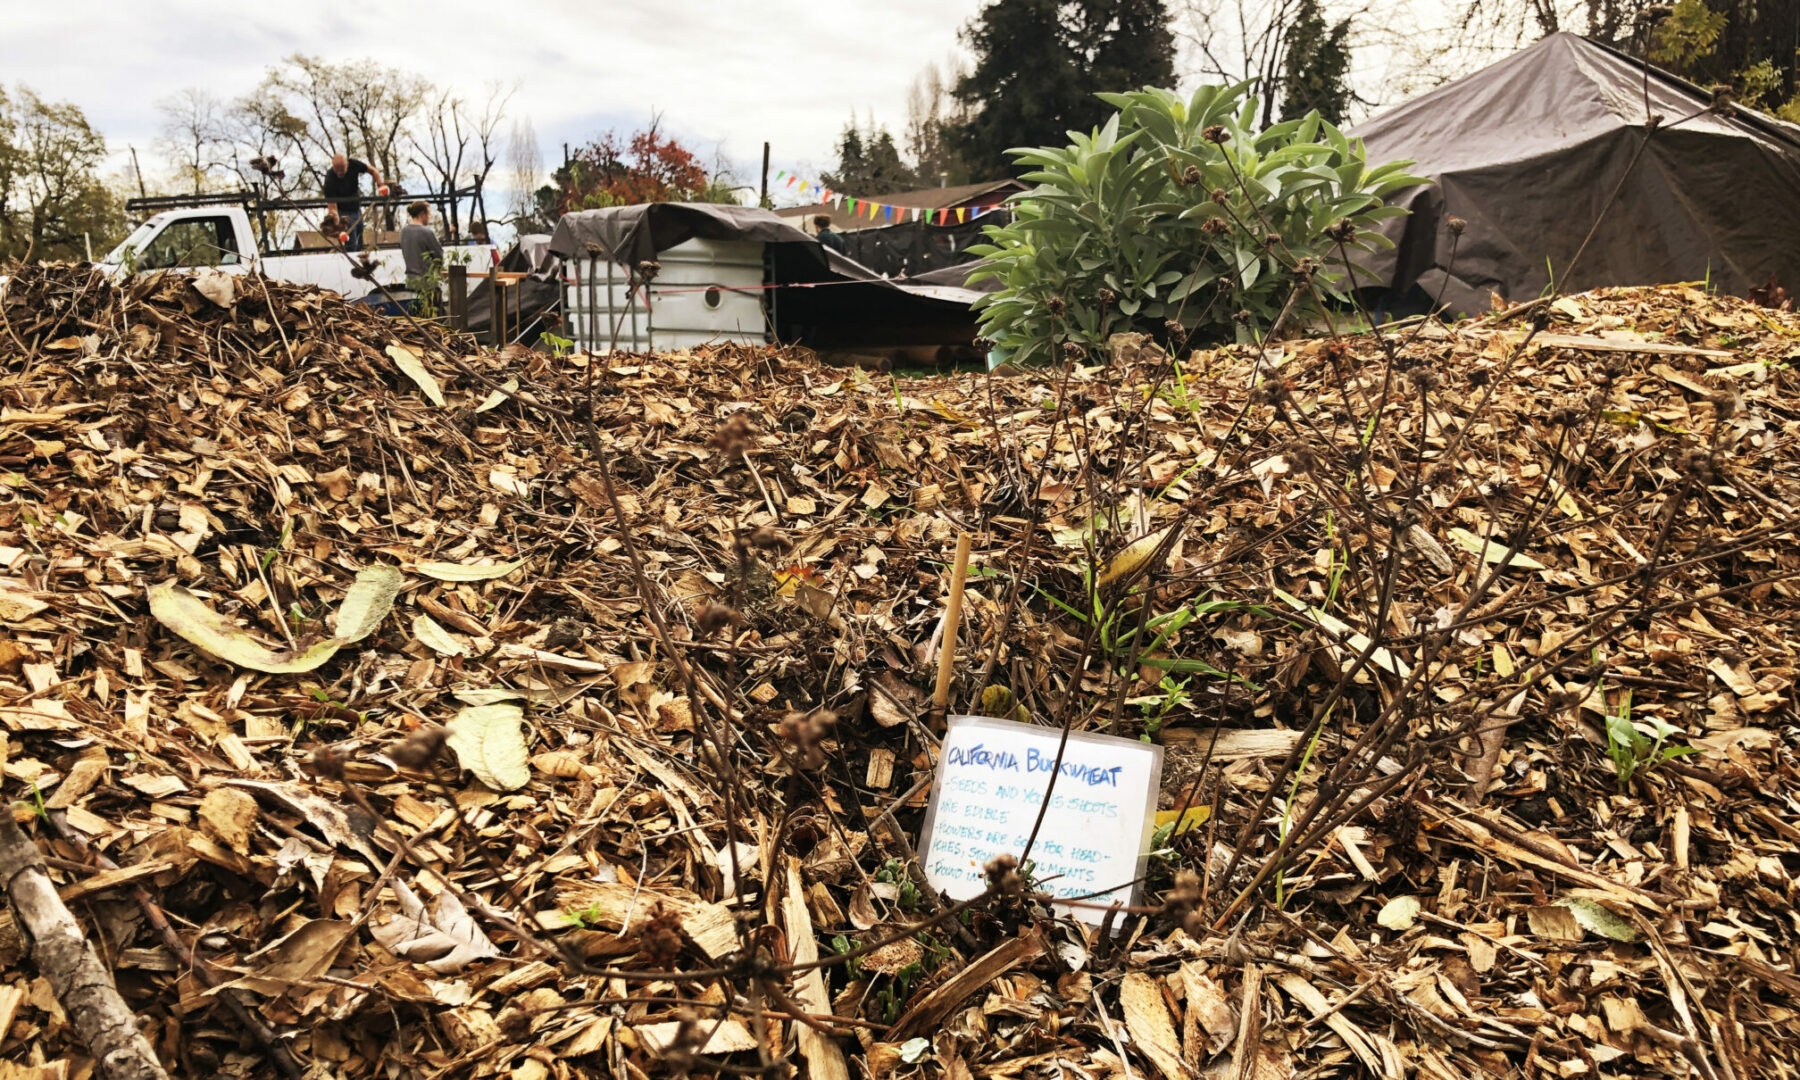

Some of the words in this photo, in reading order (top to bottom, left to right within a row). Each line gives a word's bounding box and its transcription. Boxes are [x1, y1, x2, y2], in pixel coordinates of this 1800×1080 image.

[948, 743, 1019, 772] CALIFORNIA
[1027, 747, 1123, 788] BUCKWHEAT
[941, 799, 959, 814] ARE
[964, 804, 1010, 825] EDIBLE
[996, 785, 1019, 799] AND
[1067, 798, 1118, 818] SHOOTS
[986, 831, 1008, 846] ARE
[1013, 834, 1041, 851] GOD
[1043, 840, 1065, 858] FOR
[1034, 861, 1095, 883] ILMENTS
